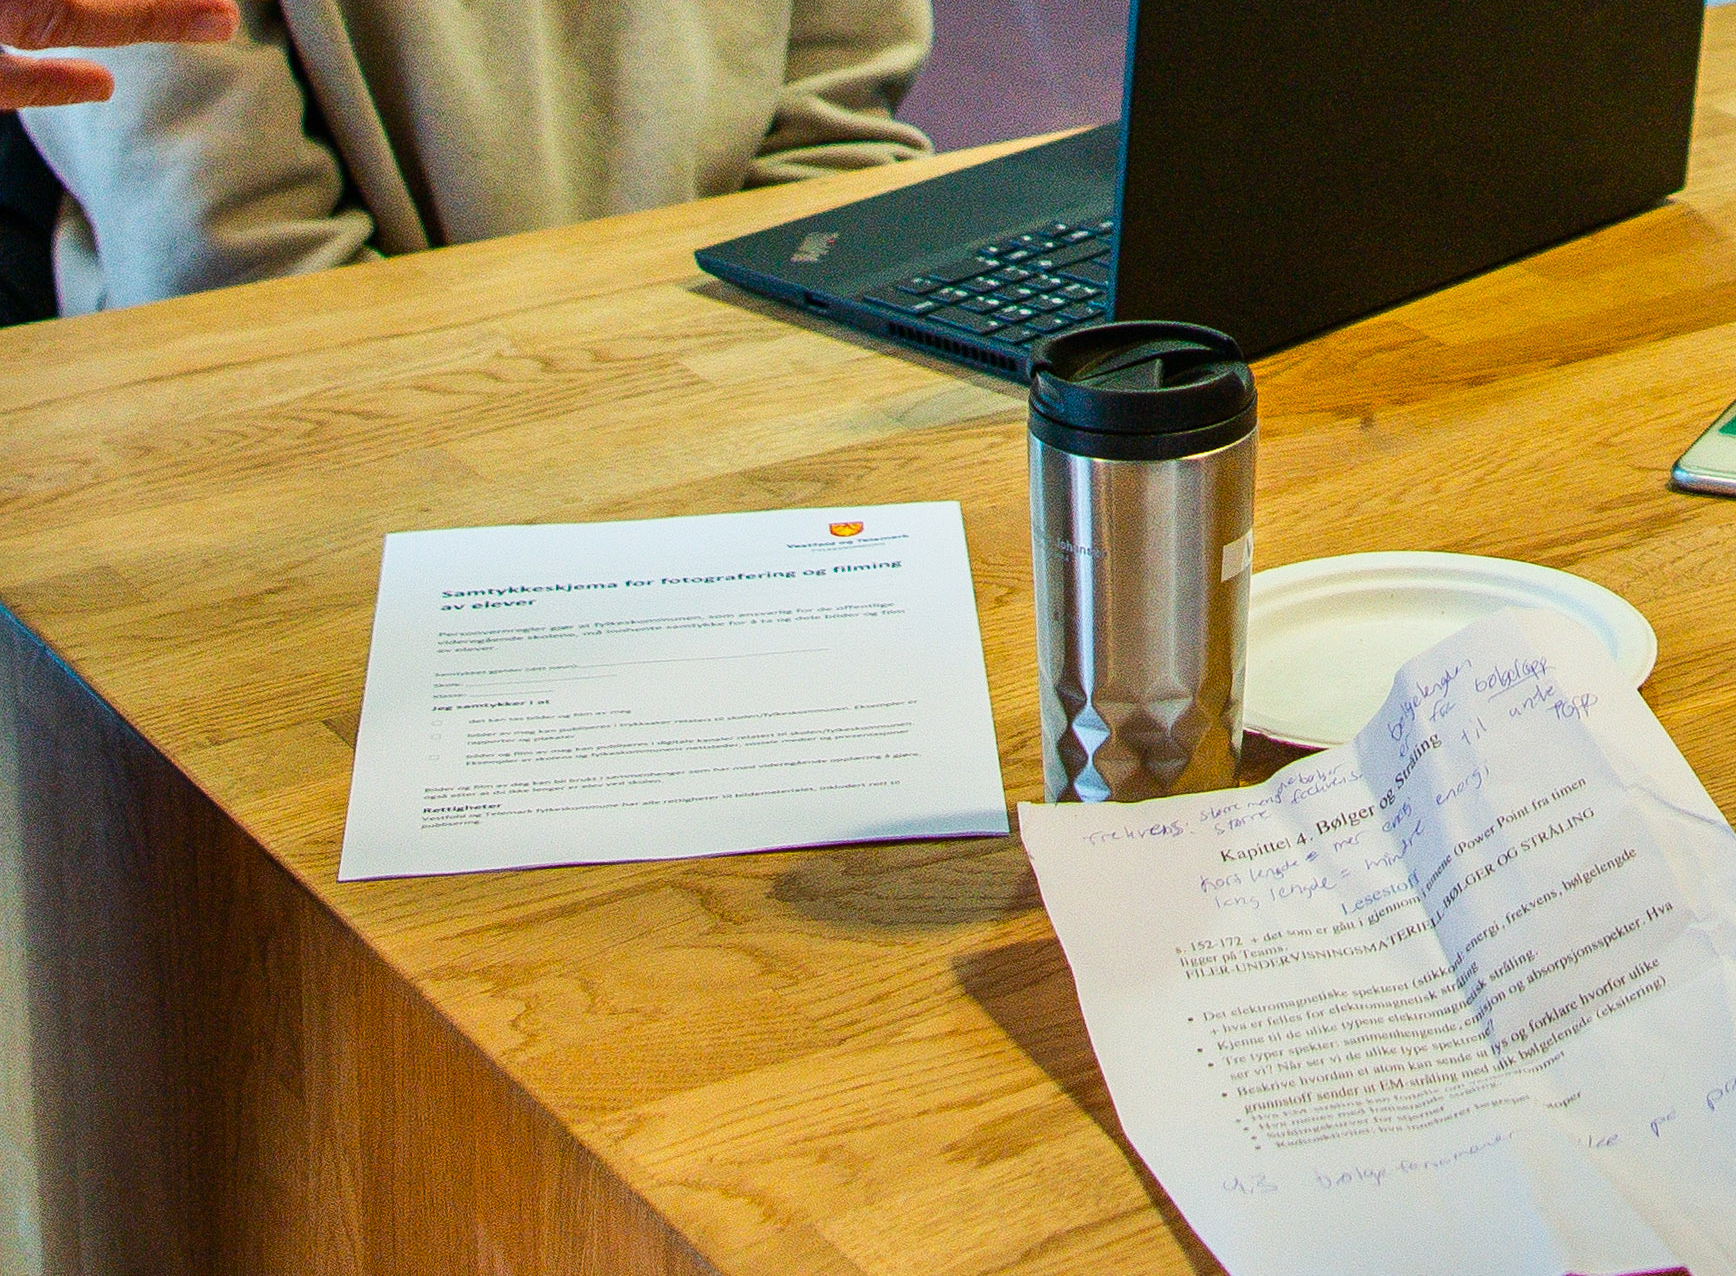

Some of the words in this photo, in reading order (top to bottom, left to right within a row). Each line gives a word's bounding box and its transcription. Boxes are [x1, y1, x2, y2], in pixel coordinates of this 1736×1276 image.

[440, 603, 465, 611] av
[471, 597, 536, 609] elever
[441, 581, 617, 599] Samtykkeskjema
[624, 577, 654, 588] for
[660, 569, 796, 585] fotografering
[803, 568, 825, 577] og
[832, 560, 901, 574] filming
[456, 700, 524, 710] samtykker
[423, 803, 500, 814] Rettigheter
[1220, 838, 1291, 863] Kapittel
[1296, 831, 1314, 846] 4.
[1315, 803, 1375, 836] Bølger
[1379, 790, 1396, 811] og
[1394, 731, 1444, 790] Stråling
[1191, 935, 1242, 952] 152-172
[1263, 931, 1283, 944] det
[1286, 927, 1313, 938] som
[1316, 926, 1328, 936] er
[1332, 918, 1356, 936] gått
[1359, 915, 1364, 928] i
[1367, 894, 1422, 926] gjennom
[1426, 853, 1453, 892] timene
[1453, 825, 1496, 858] (Power
[1496, 805, 1530, 829] Point
[1532, 795, 1550, 813] fra
[1552, 777, 1587, 802] timen
[1496, 847, 1519, 868] OG
[1519, 806, 1596, 853] STRÅLING
[1341, 867, 1420, 916] Lesestoff
[1179, 952, 1219, 968] ligger
[1222, 950, 1239, 965] på
[1240, 945, 1290, 960] Teams.
[1203, 1010, 1227, 1023] Det
[1230, 989, 1349, 1020] elektromagnetiske
[1352, 982, 1409, 999] spekteret
[1412, 950, 1465, 989] (stikkord:
[1505, 887, 1564, 925] frekvens,
[1562, 846, 1637, 893] bølgelengde
[1217, 1034, 1264, 1052] Kjenne
[1268, 1031, 1282, 1044] til
[1286, 1029, 1302, 1041] de
[1305, 1021, 1338, 1037] ulike
[1341, 1016, 1386, 1033] typene
[1388, 978, 1488, 1023] elektromagnetisk
[1488, 948, 1539, 982] stråling.
[1222, 1055, 1246, 1067] Tre
[1249, 1047, 1285, 1064] typer
[1288, 1039, 1340, 1057] spekter:
[1343, 1022, 1463, 1047] sammenhengende,
[1463, 990, 1507, 1028] emisjon
[1508, 978, 1527, 996] og
[1526, 917, 1646, 985] absorpsjonsspekter.
[1645, 900, 1675, 923] Hva
[1222, 1021, 1246, 1035] hva
[1250, 1019, 1263, 1029] er
[1267, 1012, 1303, 1028] felles
[1306, 1007, 1326, 1021] for
[1328, 991, 1438, 1017] elektromagnetisk
[1440, 960, 1480, 998] stråling
[1230, 1070, 1249, 1082] ser
[1254, 1065, 1274, 1079] vi?
[1277, 1059, 1302, 1074] Når
[1306, 1057, 1325, 1068] ser
[1329, 1053, 1342, 1065] vi
[1346, 1050, 1362, 1062] de
[1365, 1044, 1398, 1058] ulike
[1400, 1040, 1429, 1056] type
[1431, 1018, 1495, 1052] spektrene?
[1236, 1080, 1297, 1098] Beskrive
[1298, 1068, 1355, 1087] hvordan
[1357, 1067, 1370, 1077] et
[1372, 1061, 1406, 1076] atom
[1409, 1057, 1434, 1072] kan
[1436, 1050, 1473, 1066] sende
[1475, 1048, 1489, 1060] ut
[1491, 1037, 1510, 1056] lys
[1511, 1026, 1529, 1043] og
[1528, 998, 1579, 1033] forklare
[1579, 973, 1627, 1007] hvorfor
[1628, 956, 1661, 981] ulike
[1244, 1096, 1313, 1115] grunnstoff
[1316, 1086, 1360, 1103] sender
[1363, 1082, 1377, 1094] ut
[1379, 1069, 1460, 1092] EM-stråling
[1461, 1064, 1491, 1081] med
[1492, 1055, 1517, 1073] ulik
[1518, 1015, 1594, 1060] bølgelengde
[1595, 974, 1669, 1020] (eksitering)
